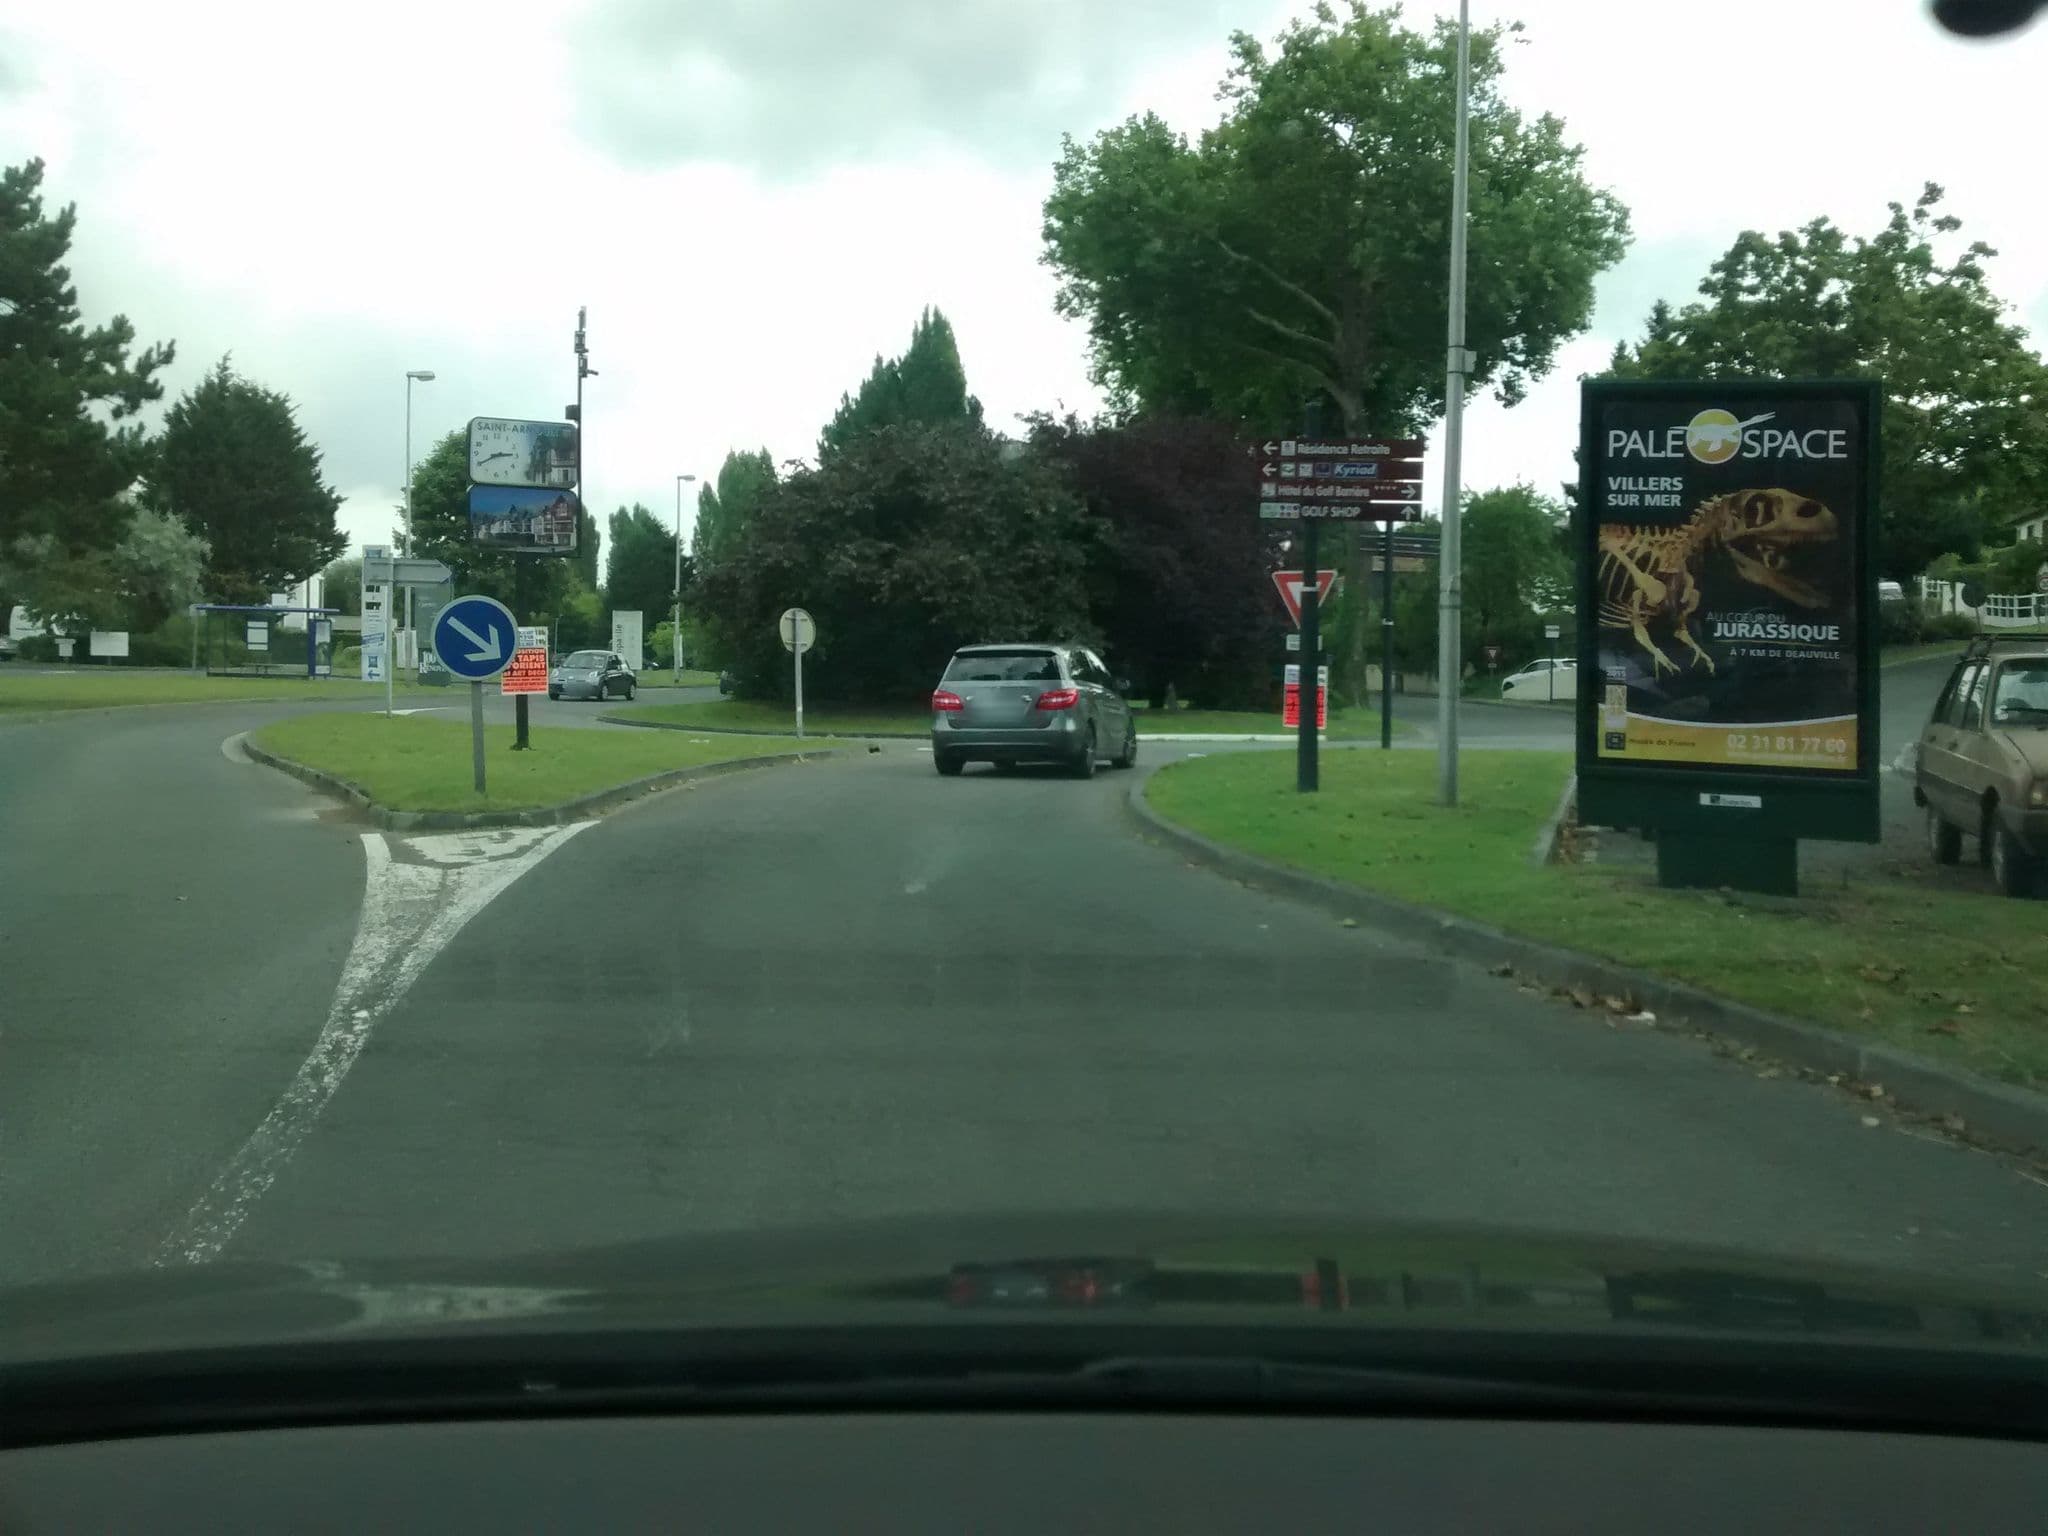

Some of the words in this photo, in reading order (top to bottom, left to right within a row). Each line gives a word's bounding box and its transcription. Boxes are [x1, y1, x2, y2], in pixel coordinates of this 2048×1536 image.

[1351, 443, 1391, 456] Retraite
[1335, 464, 1376, 478] Kyriad
[1607, 476, 1684, 491] VILLERS
[1316, 485, 1335, 497] Golf
[1607, 493, 1640, 507] SUR
[1644, 494, 1682, 507] MER
[1301, 505, 1328, 517] GOLF
[1330, 506, 1361, 518] SHOP
[1706, 611, 1723, 623] AU
[1768, 613, 1786, 624] DU
[1713, 622, 1841, 642] JURASSIQUE
[518, 654, 545, 662] TAPIS
[1740, 648, 1746, 657] 7
[1749, 649, 1767, 658] KM
[1768, 649, 1782, 659] DE
[1785, 650, 1841, 660] DEAUVILLE
[1727, 733, 1747, 748] 02
[1751, 735, 1770, 750] 31
